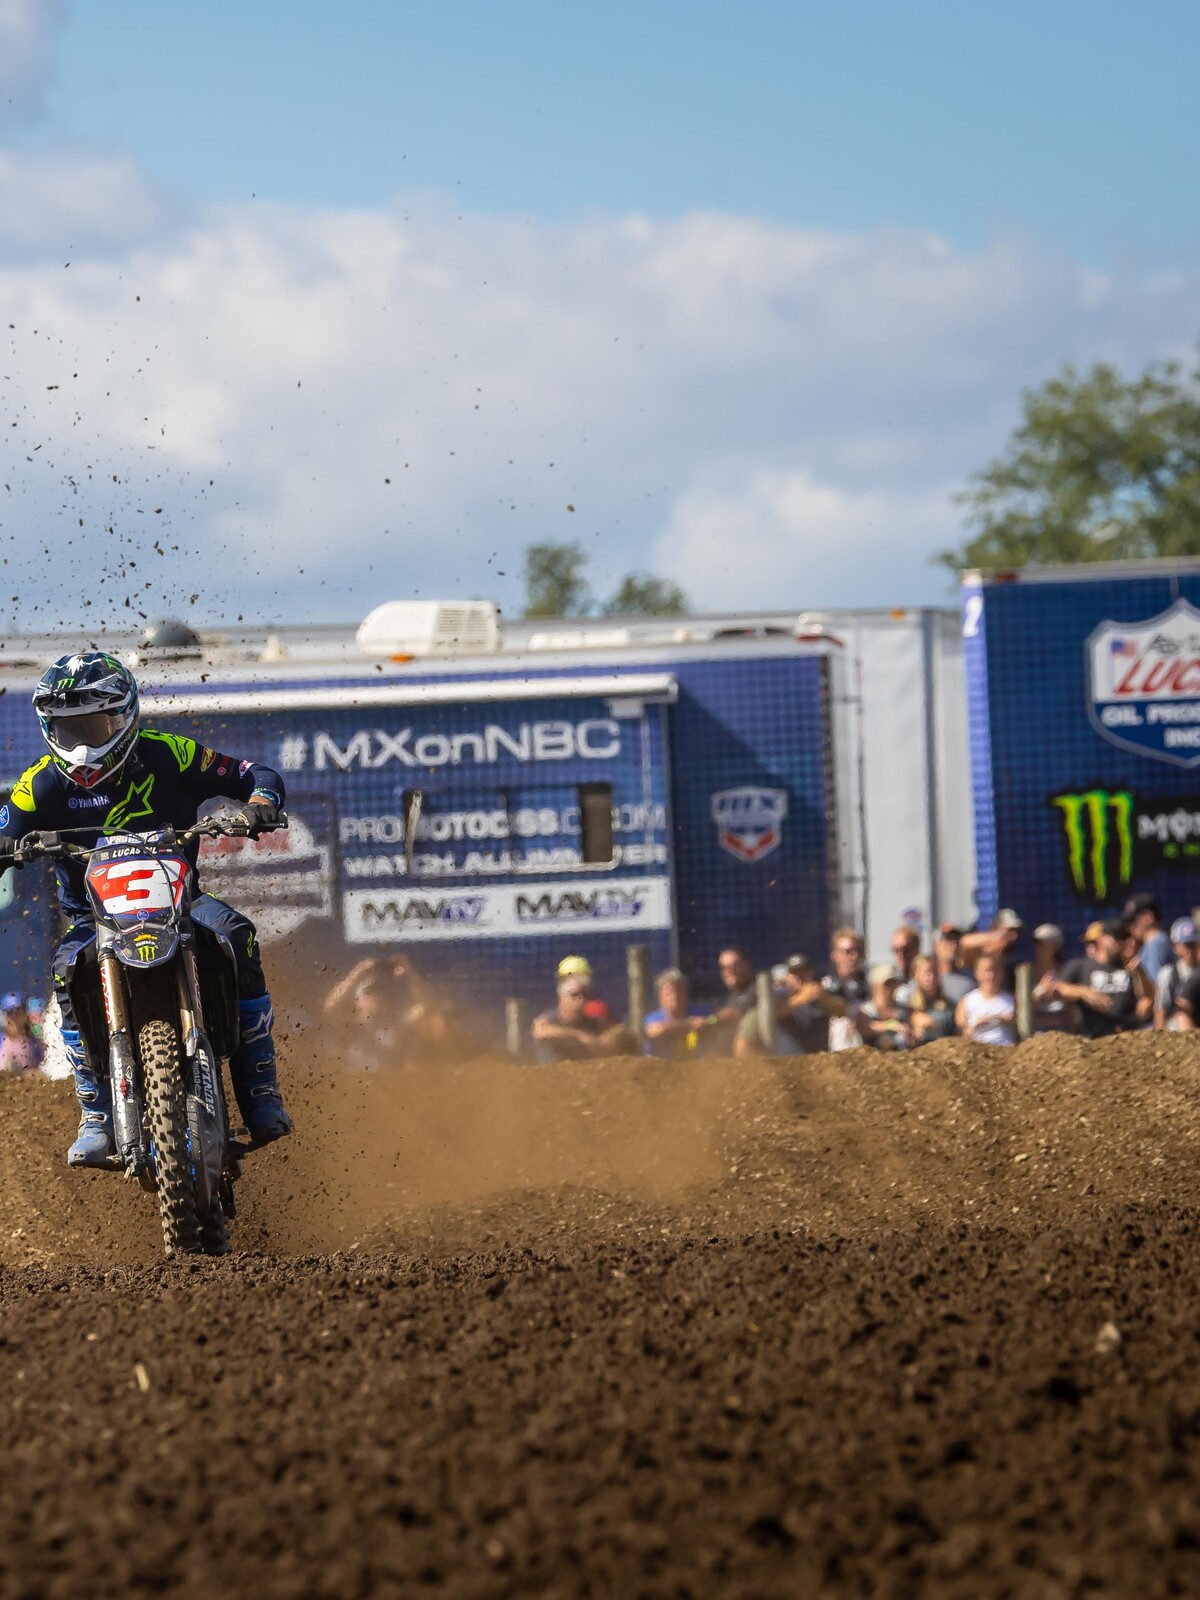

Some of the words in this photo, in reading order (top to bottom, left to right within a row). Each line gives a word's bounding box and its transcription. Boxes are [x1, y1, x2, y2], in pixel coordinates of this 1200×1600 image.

[279, 718, 622, 772] #MXonNBC
[78, 794, 110, 809] YAMAHA
[112, 847, 140, 858] LUCAS
[103, 859, 181, 914] 3
[197, 1048, 216, 1117] DUNLOP
